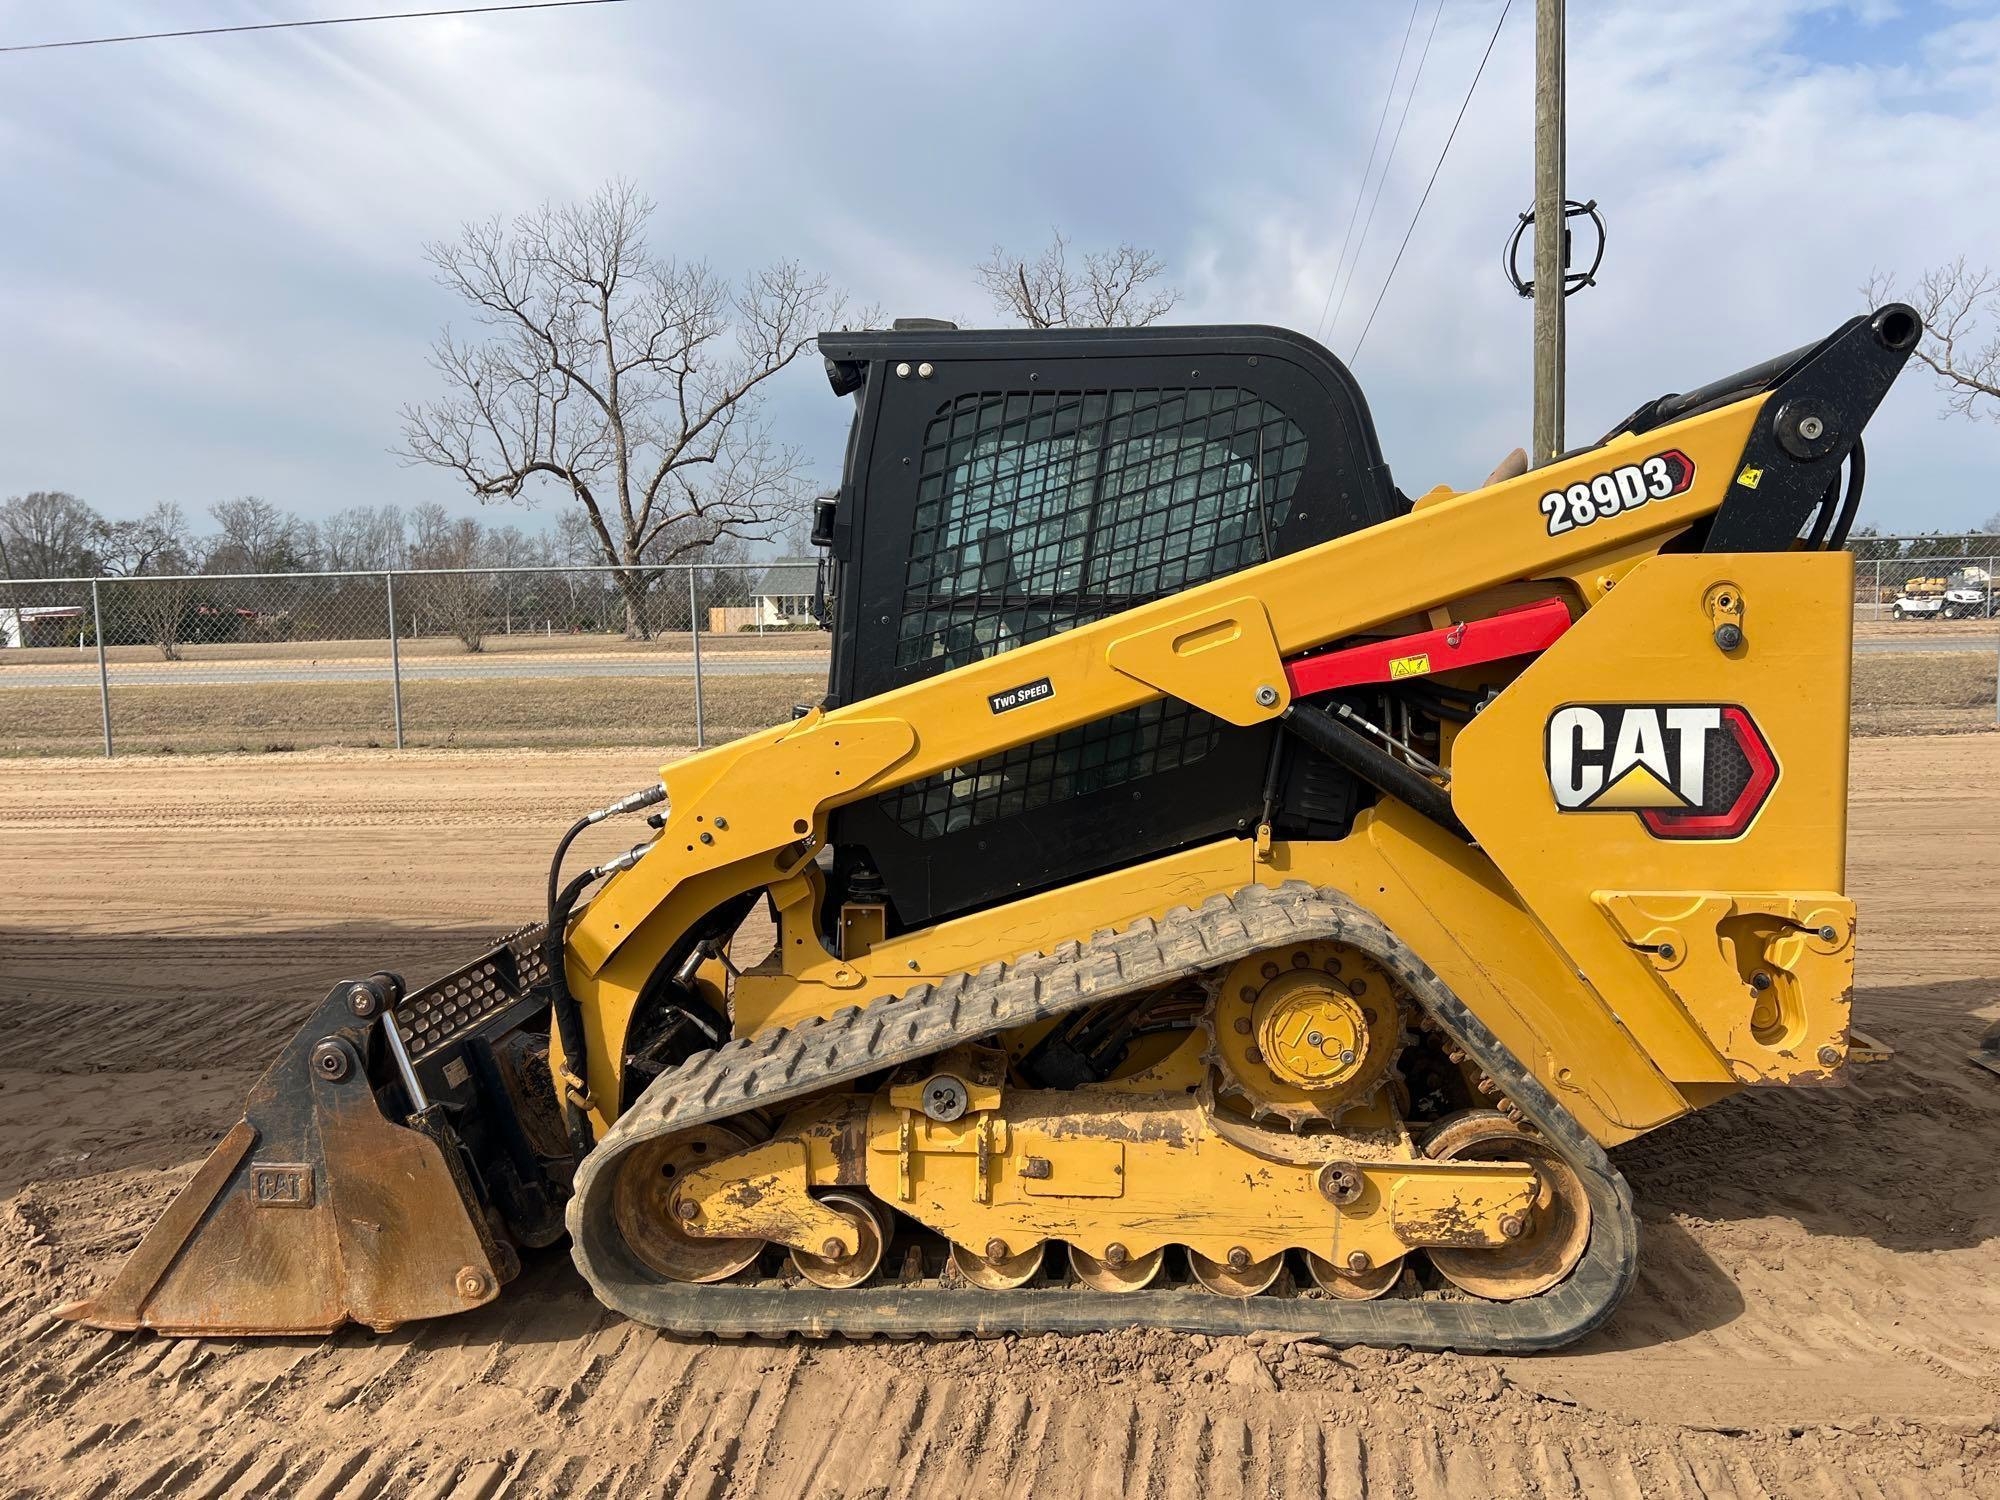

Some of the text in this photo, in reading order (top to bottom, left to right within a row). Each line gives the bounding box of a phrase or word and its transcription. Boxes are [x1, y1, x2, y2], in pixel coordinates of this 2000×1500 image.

[1542, 457, 1673, 534] 289D3
[1550, 707, 1720, 807] CAT
[258, 1173, 302, 1201] CAT
